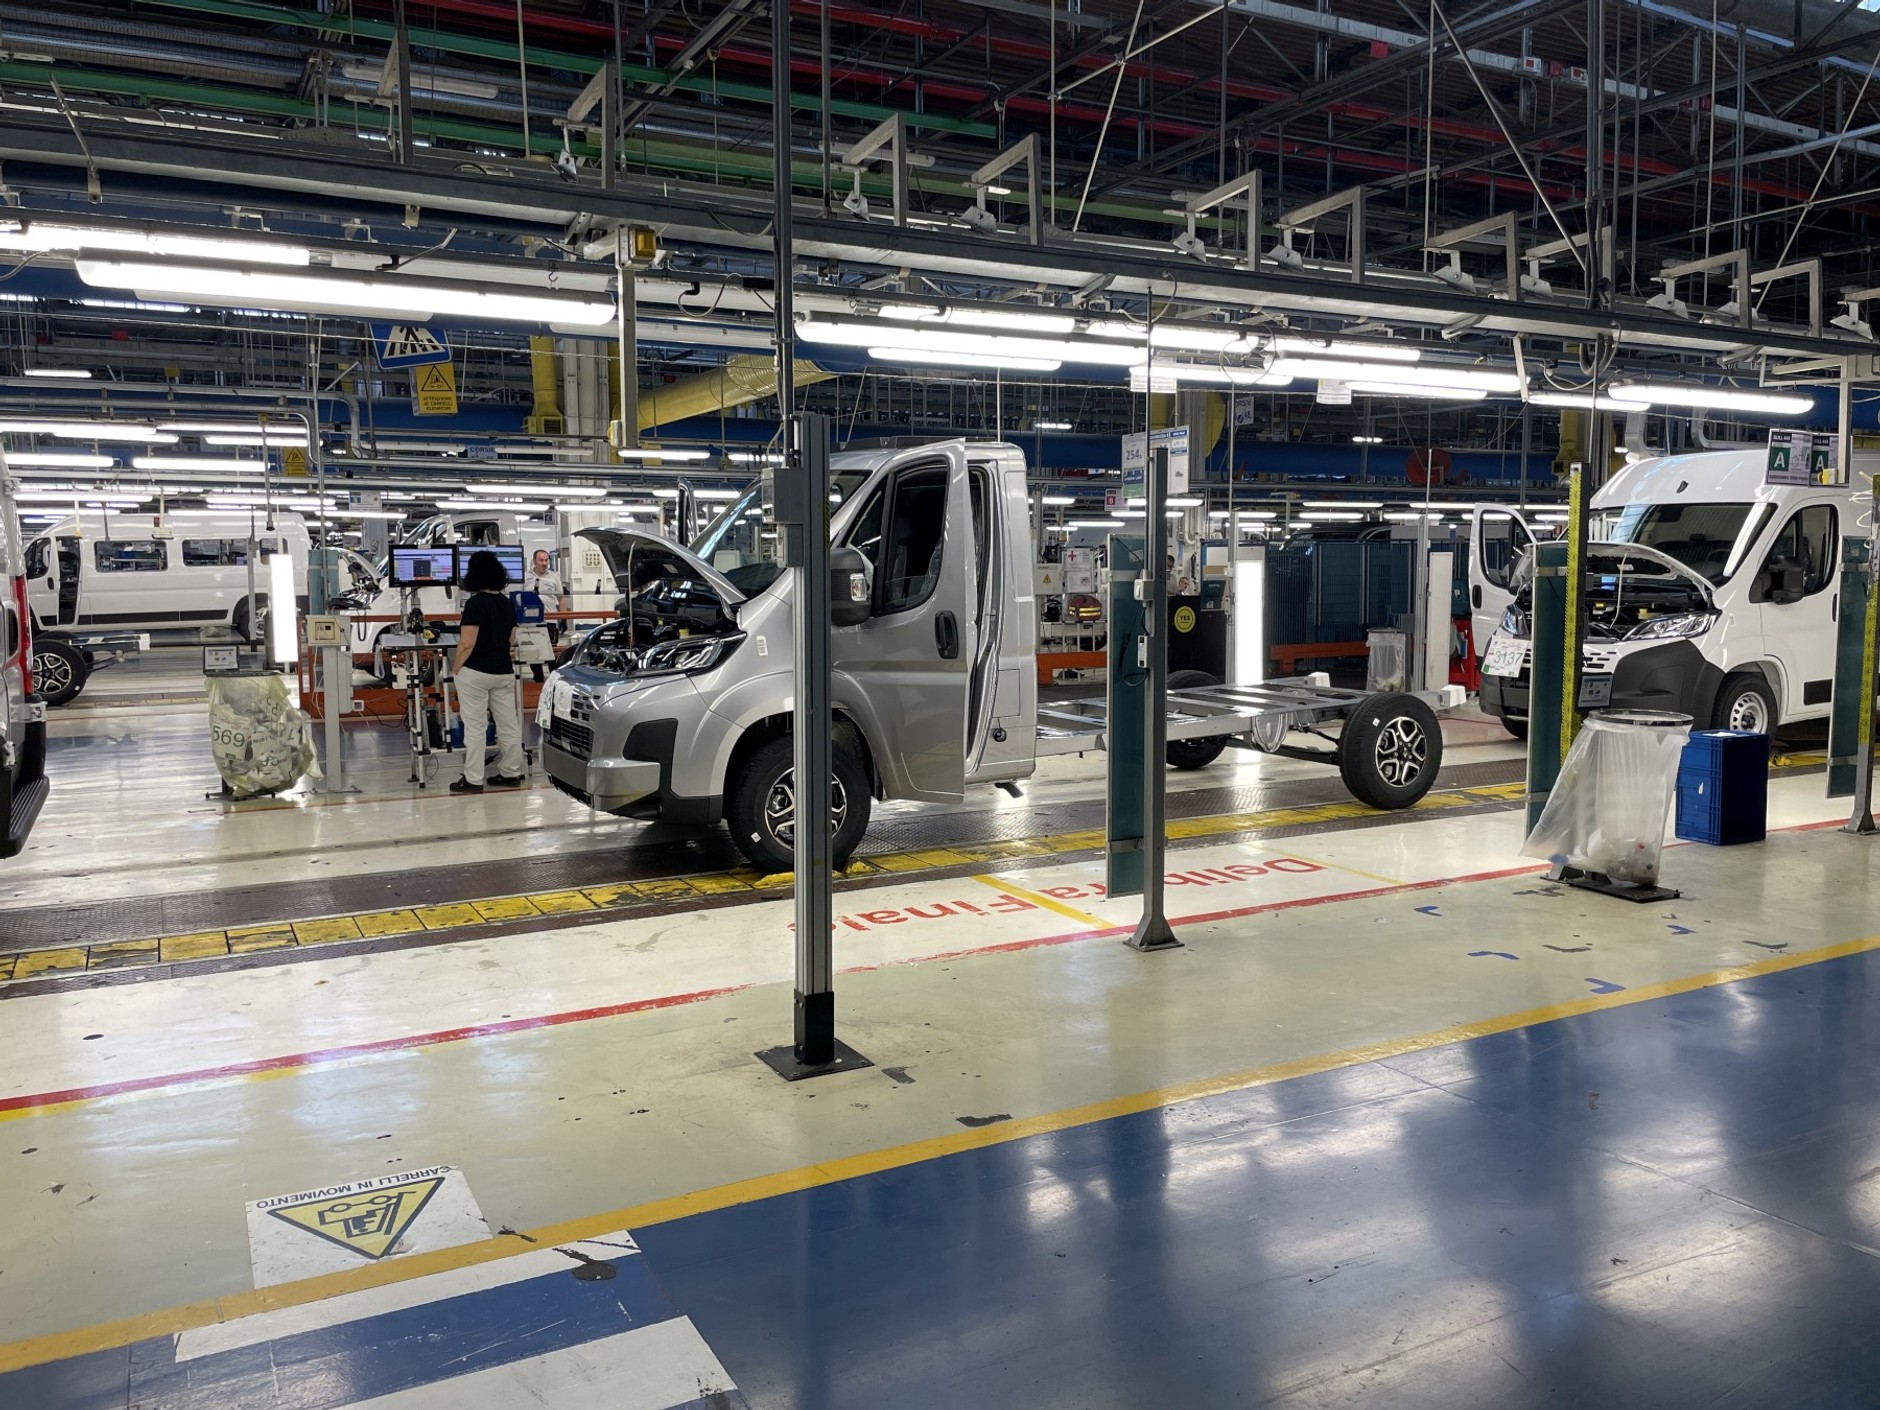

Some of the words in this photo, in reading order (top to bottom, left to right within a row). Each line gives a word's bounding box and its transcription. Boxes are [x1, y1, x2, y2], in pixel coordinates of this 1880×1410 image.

[1774, 452, 1785, 468] A
[1815, 455, 1824, 470] A
[1039, 858, 1328, 899] Delibra
[787, 894, 1039, 931] Final
[358, 1180, 373, 1190] IN
[379, 1166, 451, 1186] CARRELLI
[256, 1185, 352, 1209] MOVIMENTO
